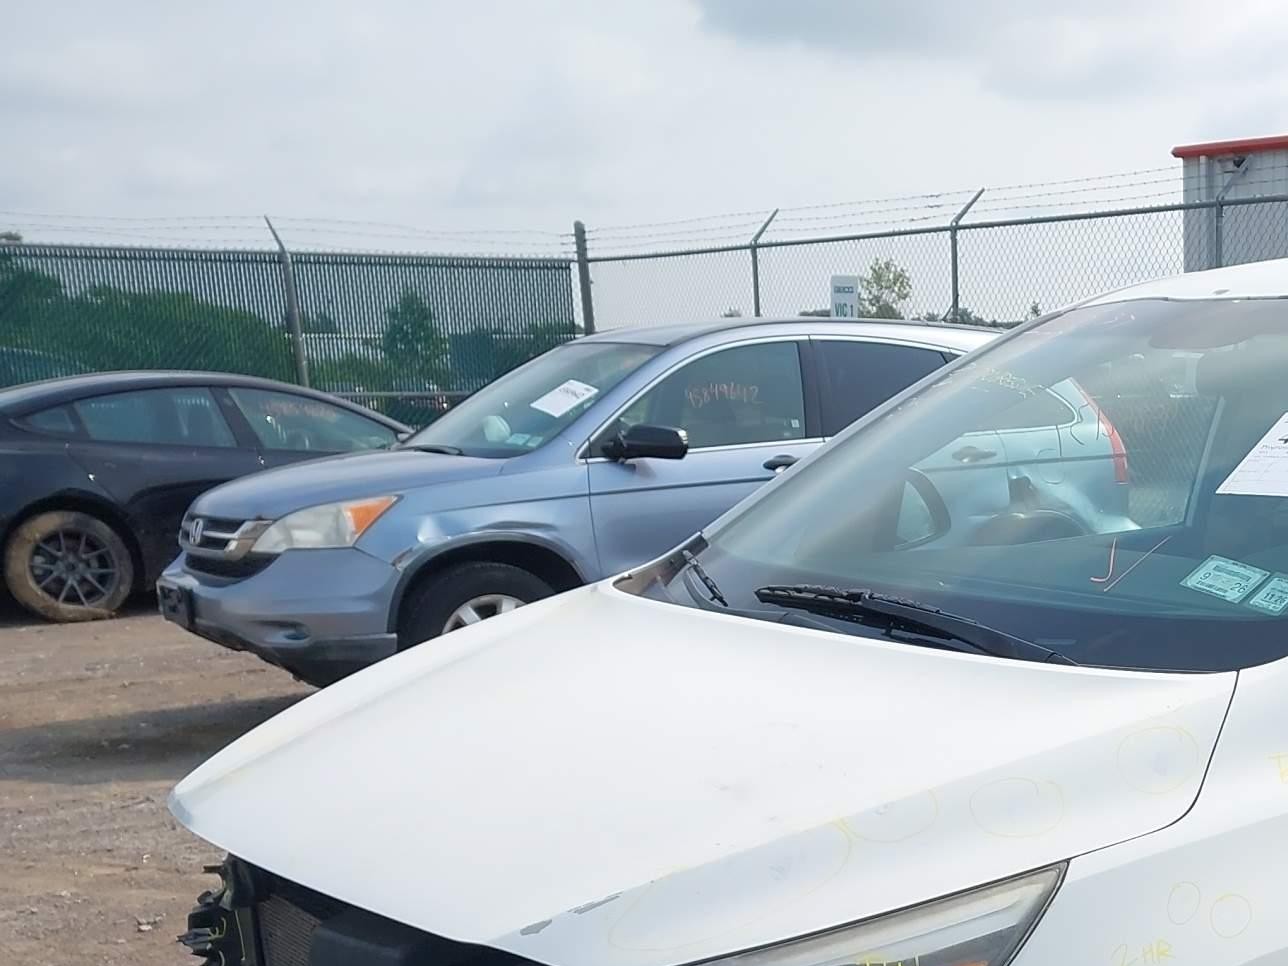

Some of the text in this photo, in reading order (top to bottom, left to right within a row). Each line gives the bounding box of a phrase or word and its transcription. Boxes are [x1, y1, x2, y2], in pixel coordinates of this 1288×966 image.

[834, 303, 848, 318] VIC
[1199, 571, 1212, 581] 9
[1230, 582, 1249, 594] 26
